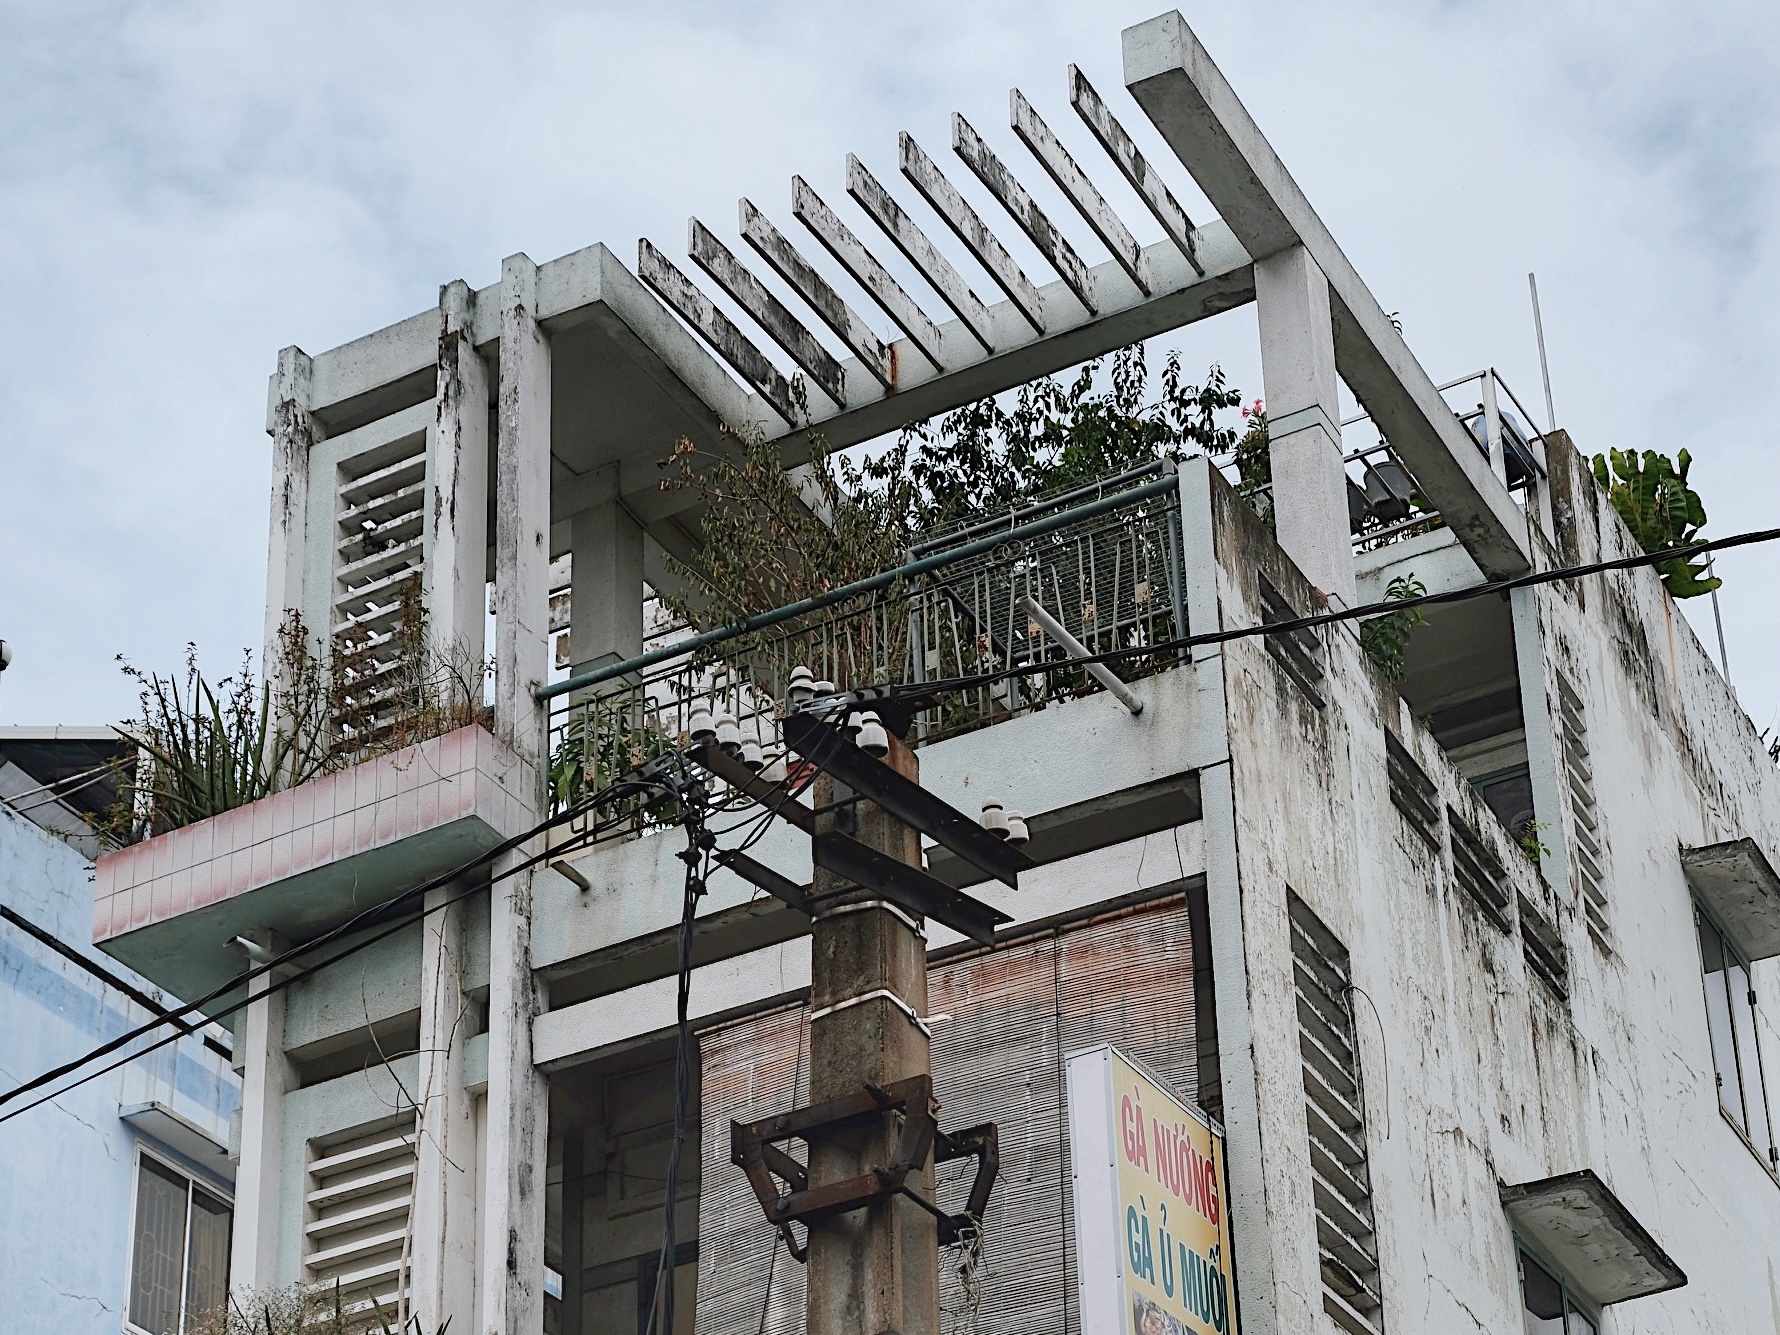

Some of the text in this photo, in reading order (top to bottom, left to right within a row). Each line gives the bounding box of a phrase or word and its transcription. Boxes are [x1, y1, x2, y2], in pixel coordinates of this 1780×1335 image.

[1122, 1085, 1218, 1225] GÀ NƯỚNG
[1127, 1195, 1155, 1286] GÀ
[1159, 1203, 1174, 1298] Ủ
